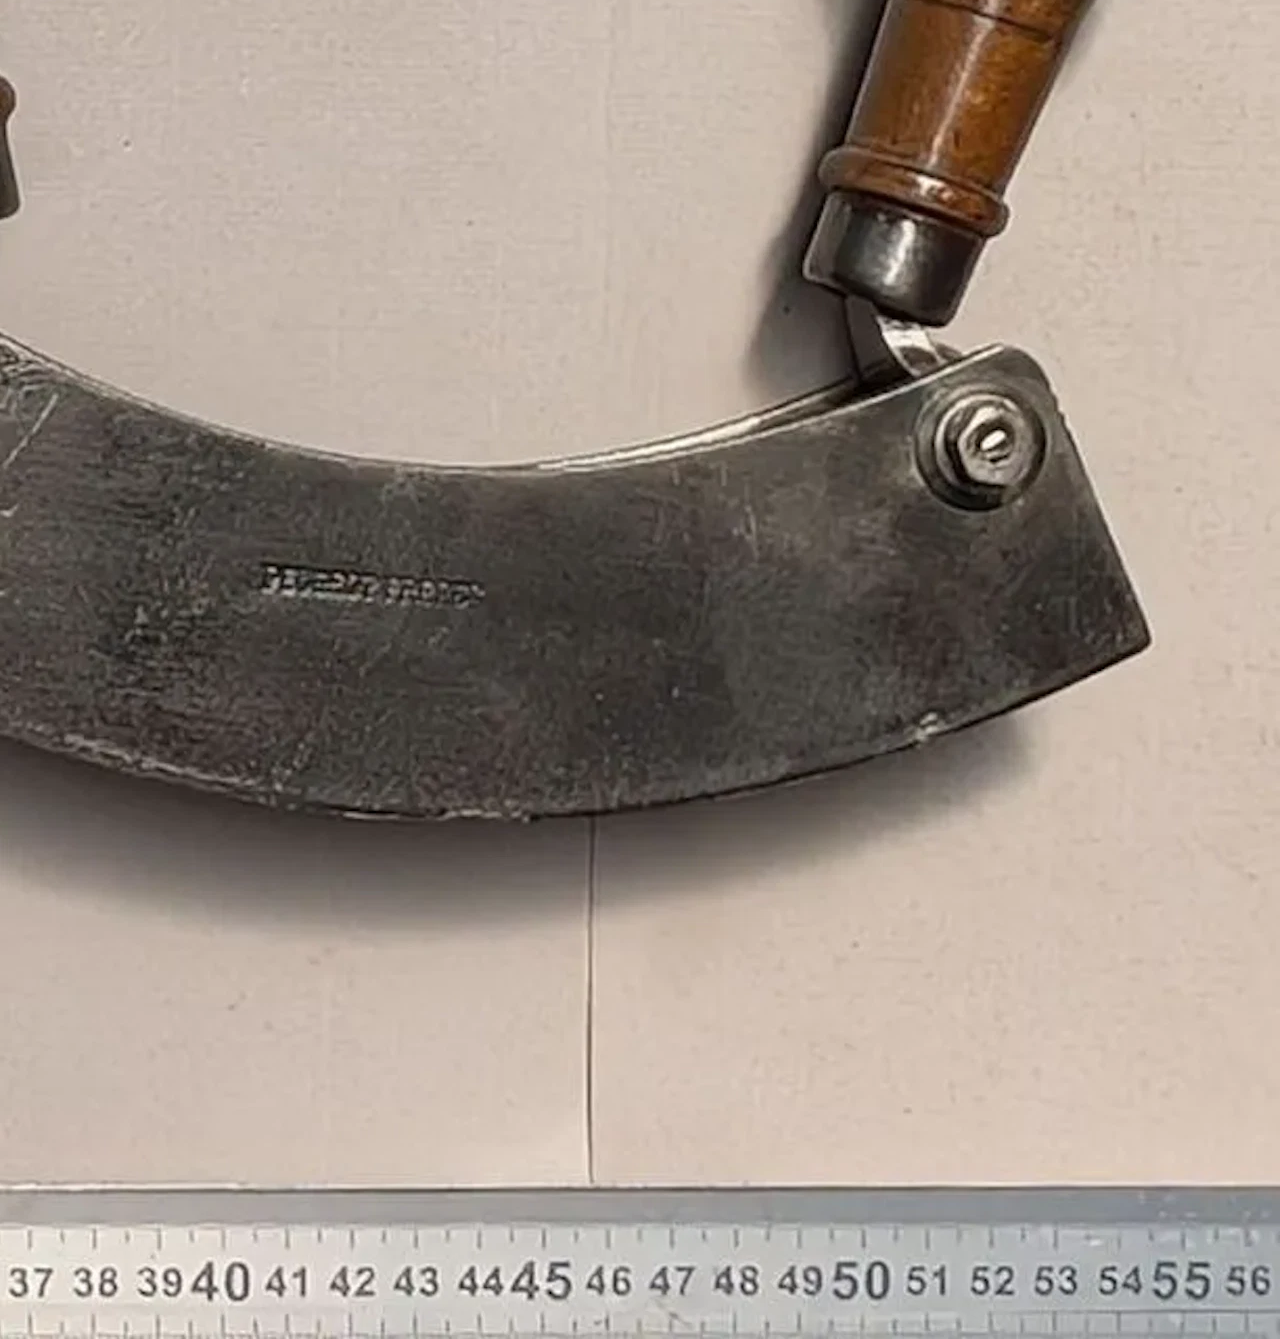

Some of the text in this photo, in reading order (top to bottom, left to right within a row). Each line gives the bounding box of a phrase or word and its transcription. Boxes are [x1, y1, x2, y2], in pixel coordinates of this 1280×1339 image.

[8, 1267, 55, 1299] 37
[72, 1266, 119, 1299] 38
[136, 1266, 183, 1298] 39
[190, 1260, 251, 1303] 40
[264, 1265, 307, 1299] 41
[328, 1265, 376, 1298] 42
[392, 1265, 440, 1298] 43
[457, 1265, 505, 1298] 44
[509, 1260, 573, 1302] 45
[585, 1264, 632, 1297] 46
[648, 1265, 697, 1298] 47
[713, 1265, 760, 1297] 48
[777, 1264, 823, 1298] 49
[832, 1260, 891, 1302] 50
[906, 1264, 947, 1297] 51
[970, 1265, 1016, 1297] 52
[1033, 1265, 1079, 1297] 53
[1098, 1265, 1143, 1296] 54
[1151, 1260, 1211, 1302] 55
[1225, 1264, 1271, 1297] 56
